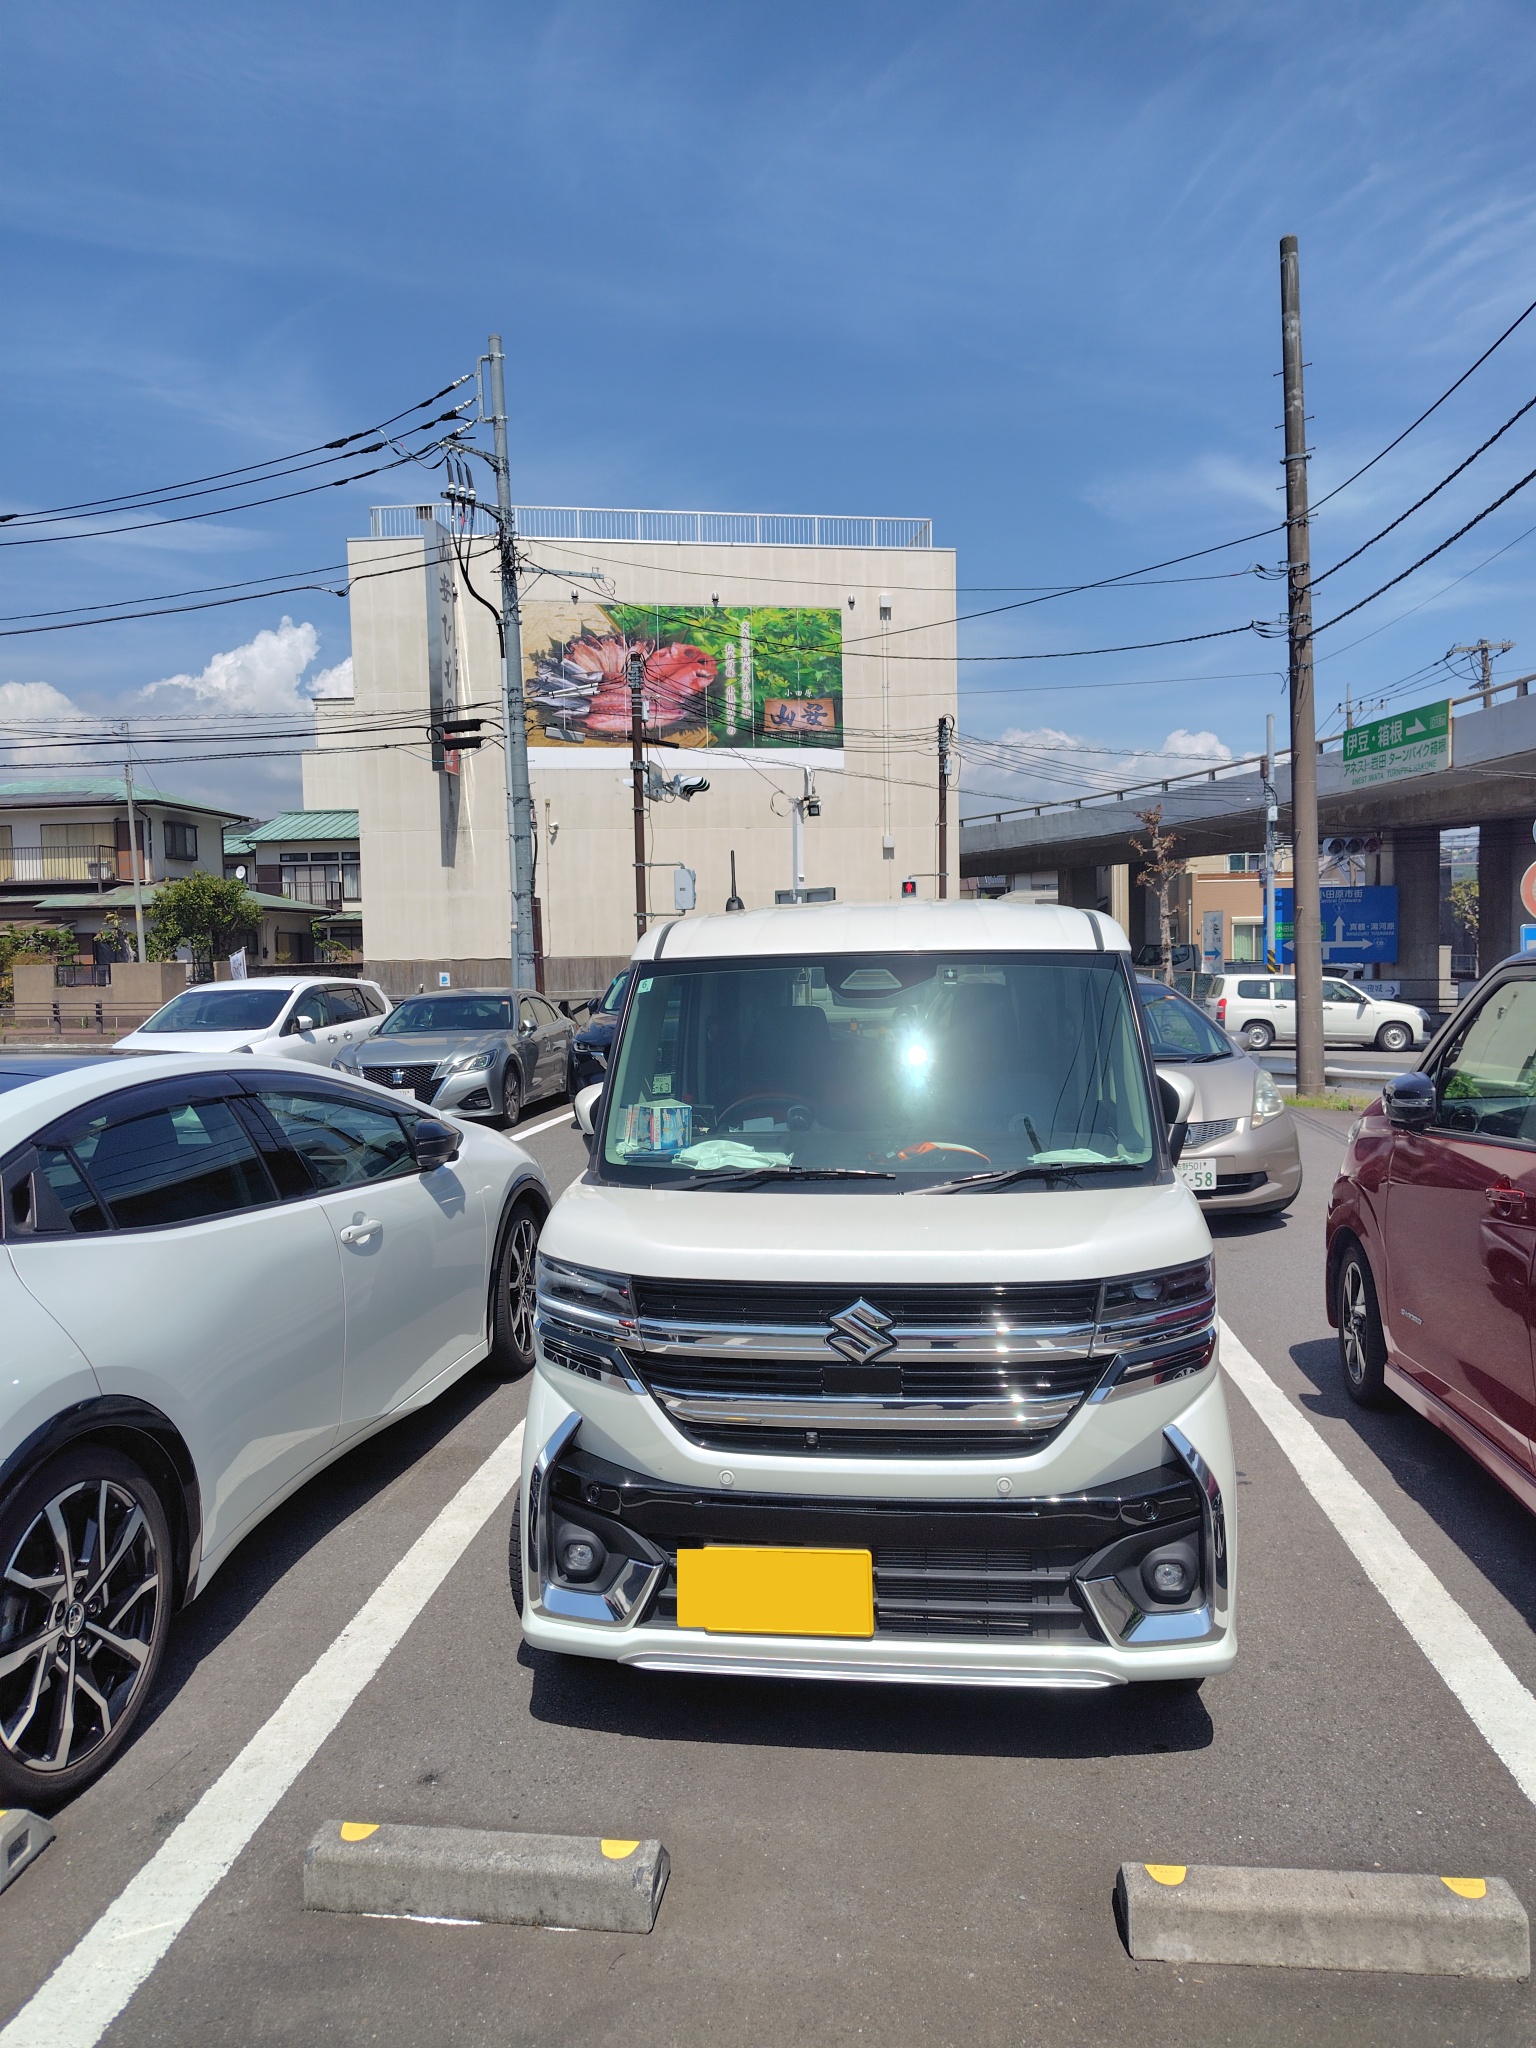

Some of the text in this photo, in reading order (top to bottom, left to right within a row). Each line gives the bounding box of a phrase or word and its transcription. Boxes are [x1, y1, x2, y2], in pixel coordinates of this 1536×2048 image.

[784, 688, 813, 697] 小田原
[771, 702, 829, 727] 山安
[1346, 720, 1403, 756] 伊豆・箱根
[1344, 754, 1387, 777] アネスト岩田
[1352, 775, 1368, 786] ANEST
[1350, 922, 1395, 931] 真鶴・湯河原
